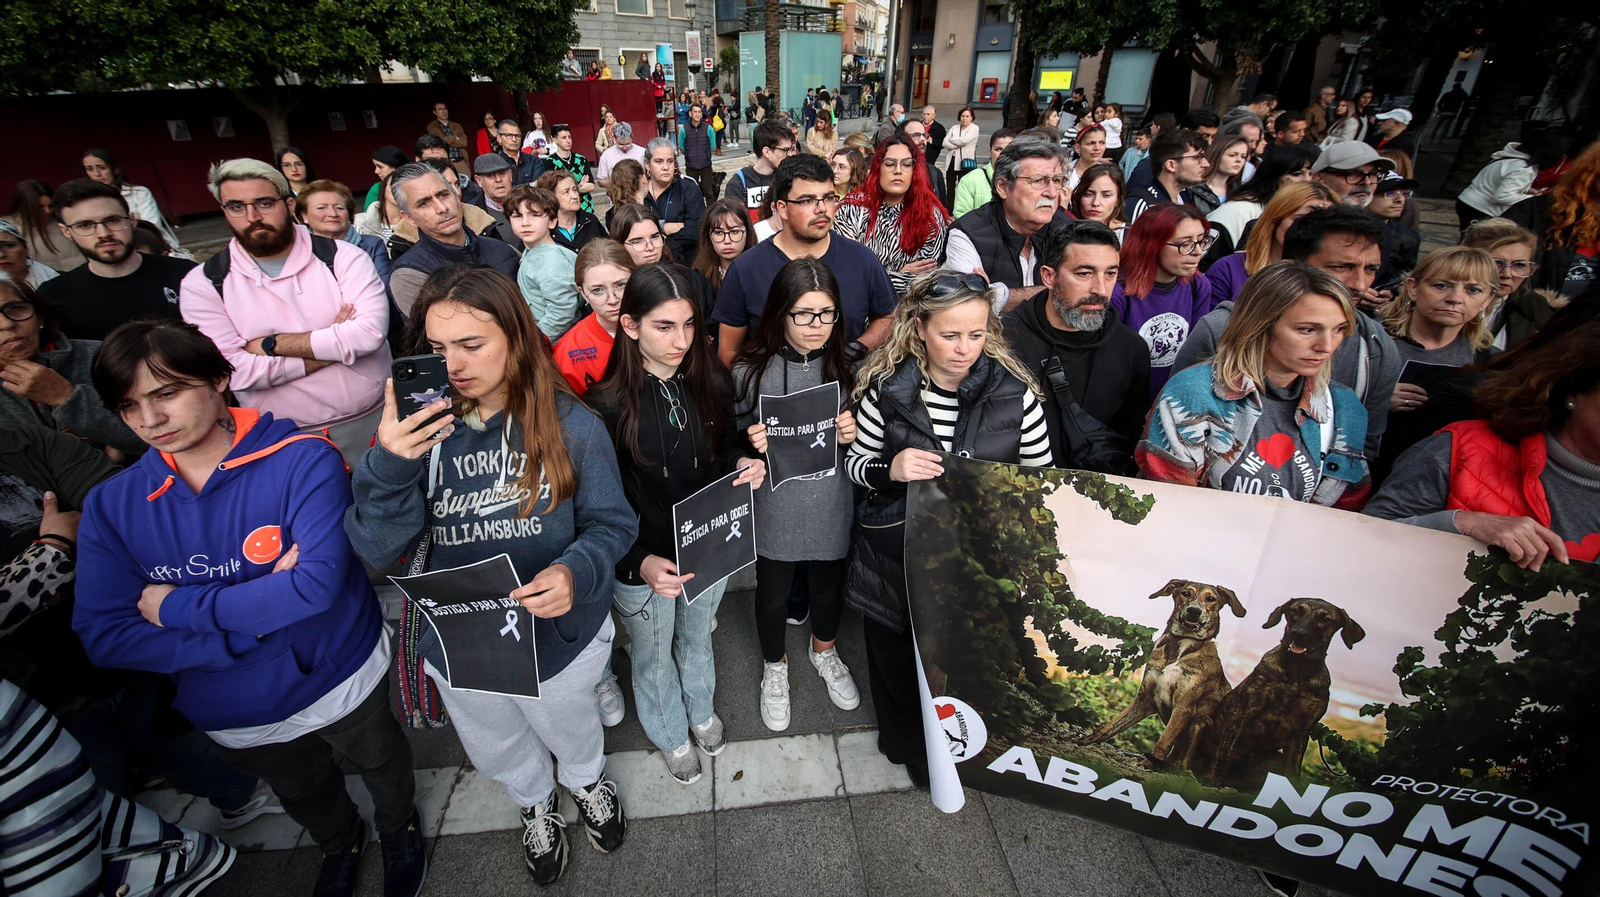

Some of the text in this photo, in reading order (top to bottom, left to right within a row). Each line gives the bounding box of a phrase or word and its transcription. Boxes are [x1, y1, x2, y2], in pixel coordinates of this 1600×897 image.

[766, 418, 835, 437] JUSTICIA PARA ODDIE
[453, 449, 502, 480] YORK
[1240, 451, 1266, 475] ME
[1232, 475, 1263, 495] NO
[681, 503, 749, 548] JUSTICIA PARA ODDIE
[429, 602, 471, 617] JUSTICIA
[472, 599, 501, 612] PARA
[954, 711, 969, 741] ABANDONES
[1371, 774, 1590, 846] PROTECTORA
[1252, 771, 1582, 897] NO ME
